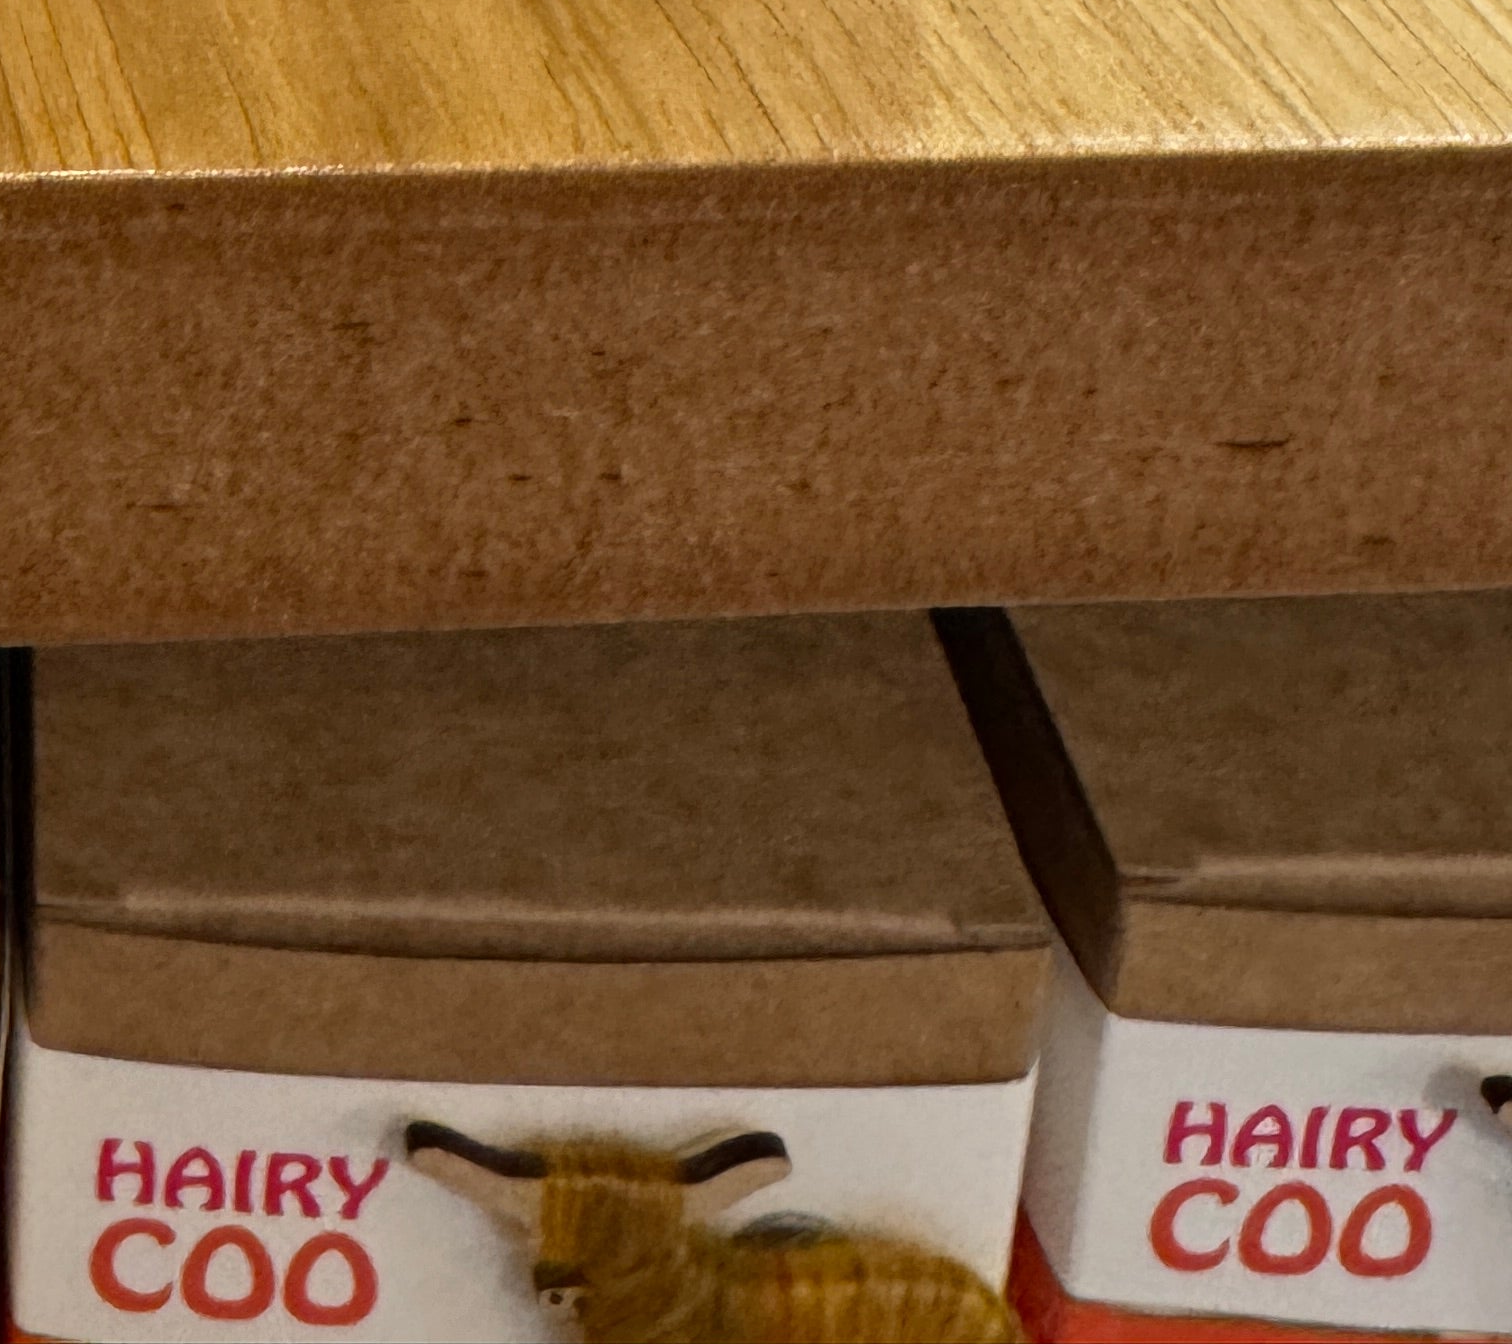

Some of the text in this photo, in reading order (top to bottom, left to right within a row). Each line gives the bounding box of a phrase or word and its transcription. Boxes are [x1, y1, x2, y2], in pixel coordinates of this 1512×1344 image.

[96, 1137, 389, 1221] HAIRY
[1163, 1101, 1458, 1174] HAIRY
[90, 1217, 379, 1327] COO
[1149, 1178, 1433, 1278] COO
